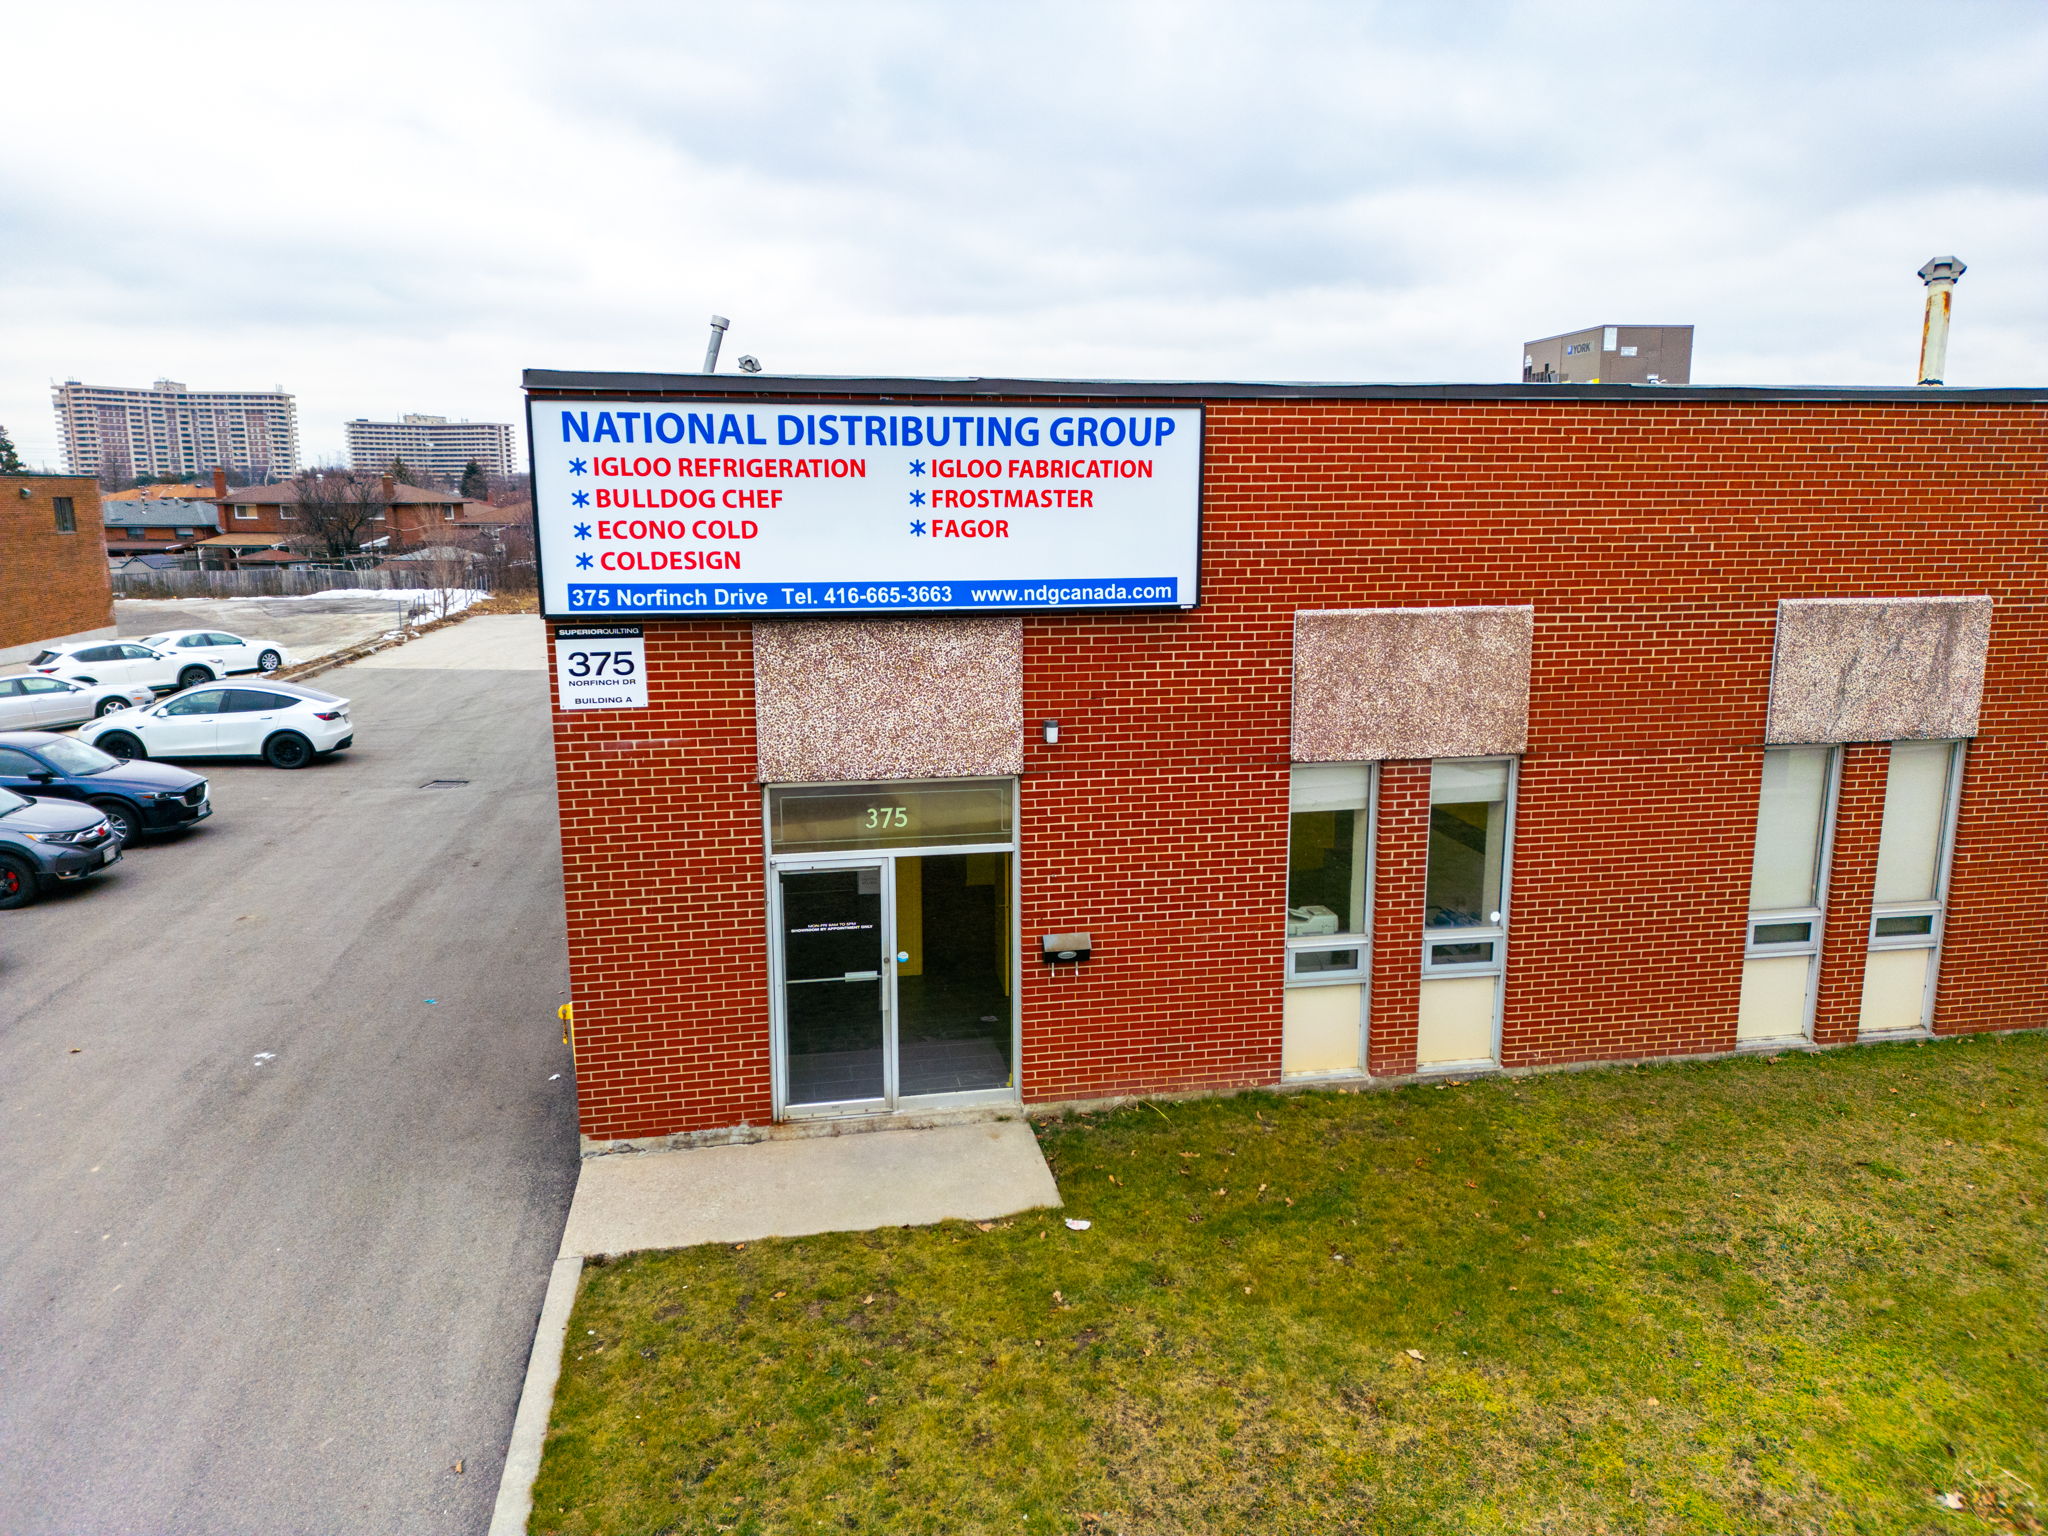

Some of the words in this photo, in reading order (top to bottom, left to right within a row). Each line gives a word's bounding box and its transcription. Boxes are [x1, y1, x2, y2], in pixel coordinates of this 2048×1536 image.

[1574, 343, 1590, 354] YORK
[561, 411, 767, 446] NATIONAL
[778, 414, 1040, 447] DISTRIBUTING
[1049, 416, 1176, 447] GROUP
[593, 457, 671, 478] IGLOO
[678, 458, 866, 478] REFRIGERATION
[932, 459, 1001, 479] IGLOO
[1008, 459, 1153, 479] FABRICATION
[596, 489, 716, 509] BULLDOG
[722, 489, 783, 509] CHEF
[931, 489, 1094, 508] FROSTMASTER
[598, 520, 685, 540] ECONO
[692, 520, 758, 540] COLD
[931, 519, 1009, 538] FAGOR
[600, 551, 741, 571] COLDESIGN
[572, 589, 610, 606] 375
[617, 588, 707, 606] Norfinch
[714, 588, 768, 606] Drive
[781, 587, 817, 605] Tel.
[824, 586, 952, 605] 416-665-3663
[971, 583, 1172, 605] www.ndgcanada.com
[568, 651, 635, 677] 375
[865, 807, 908, 829] 375
